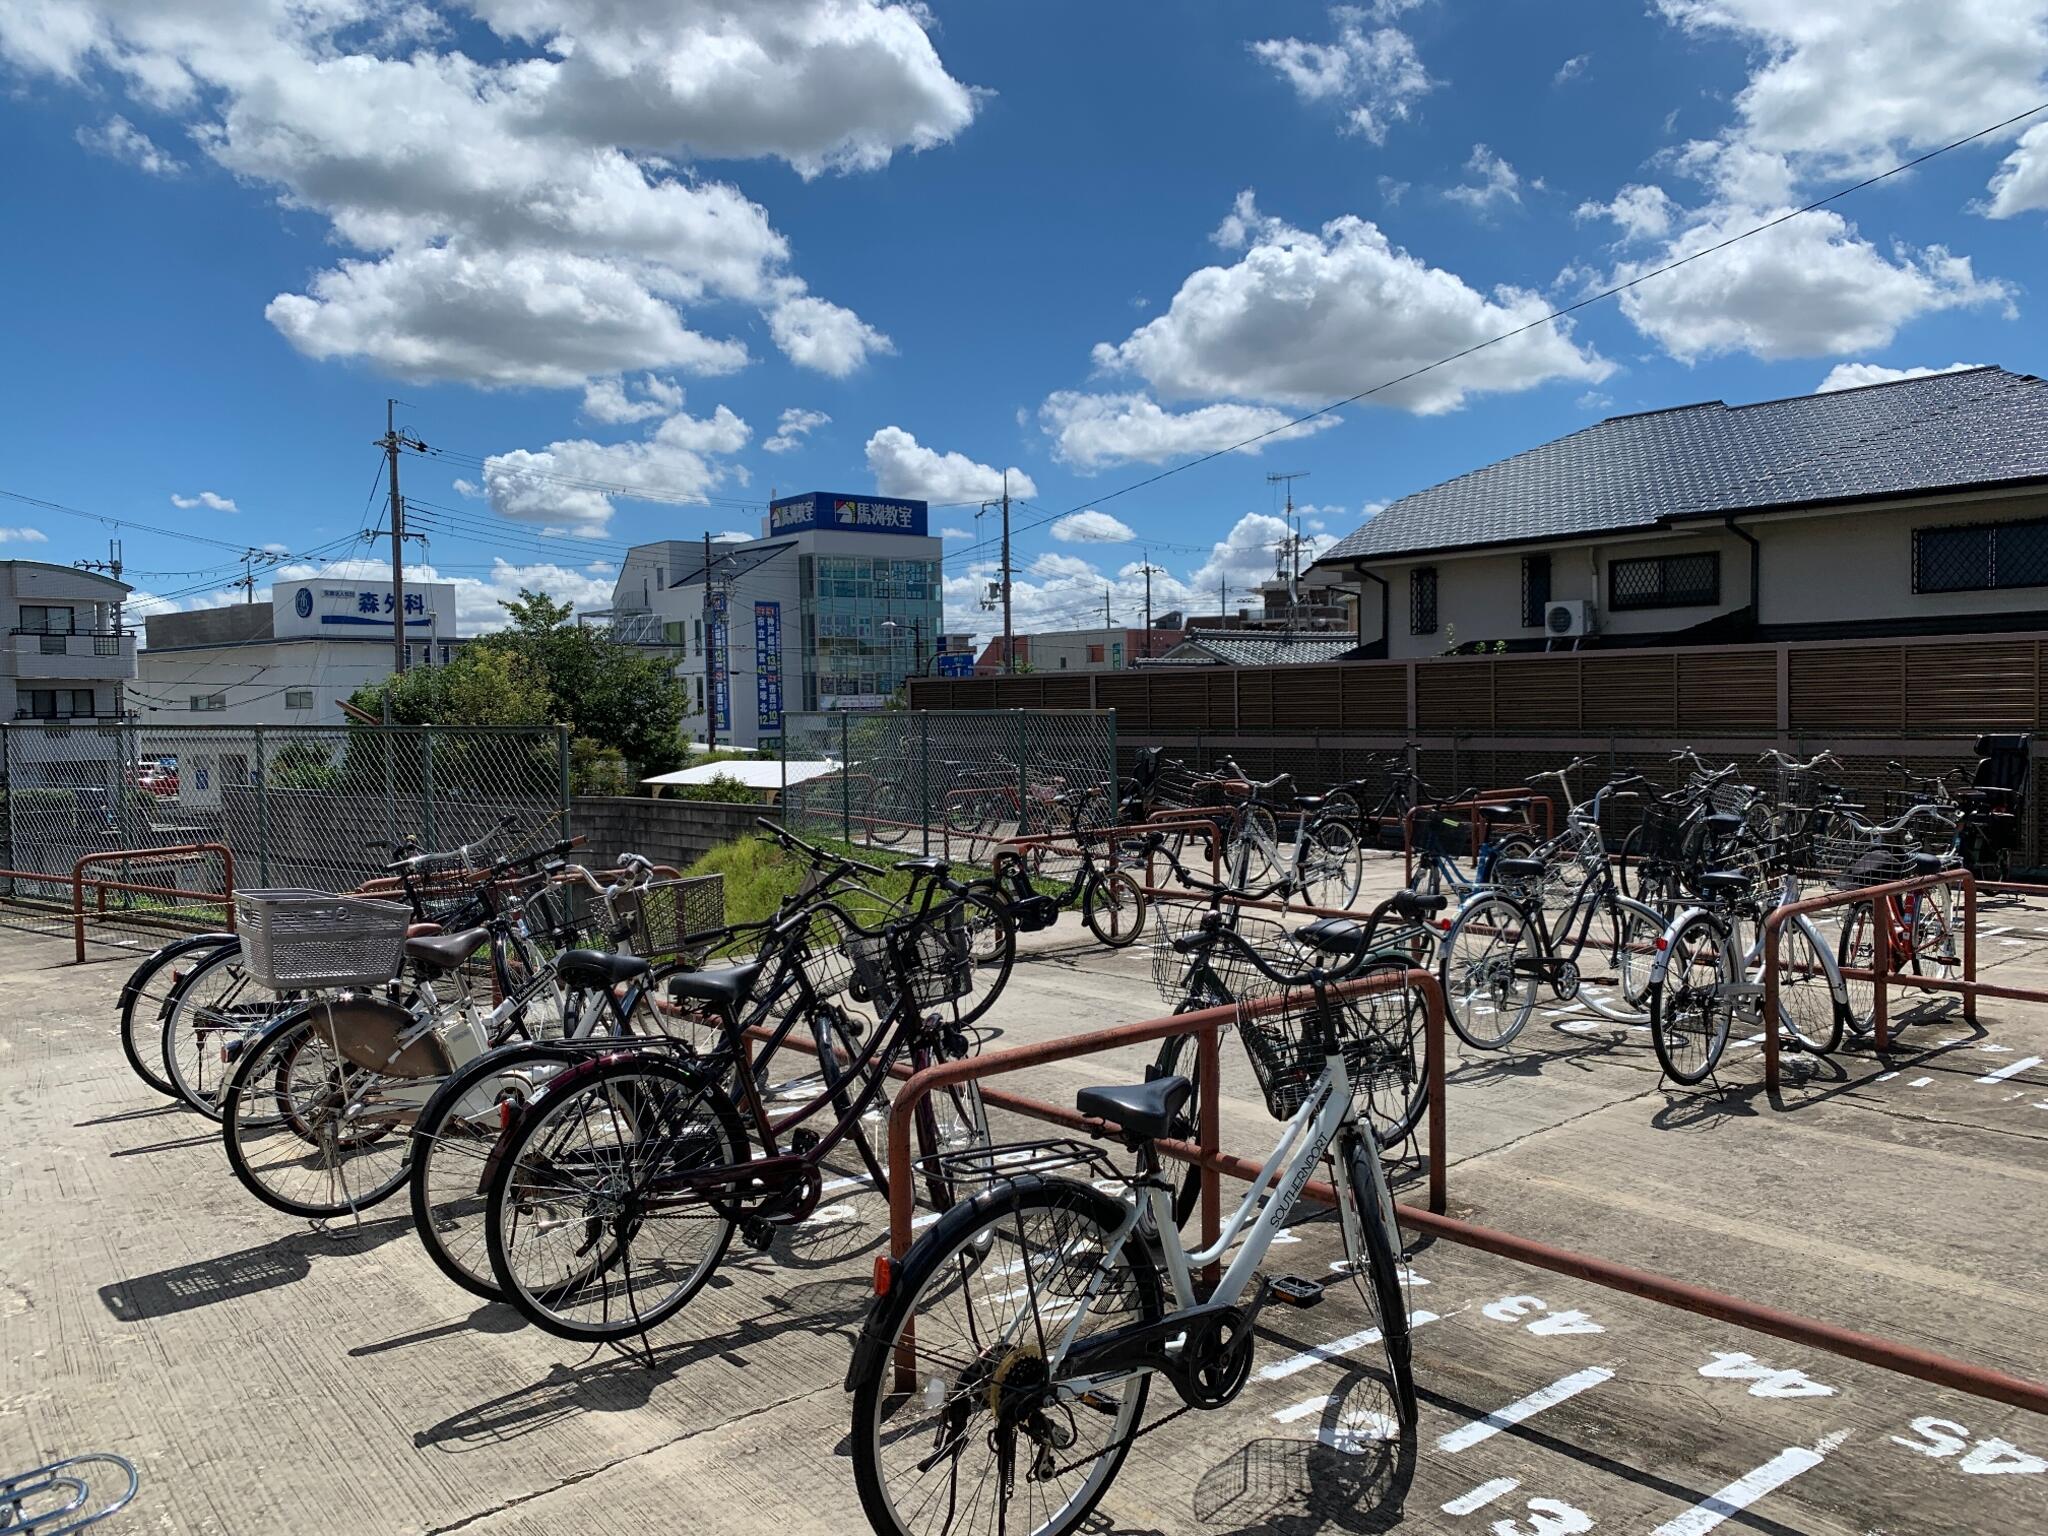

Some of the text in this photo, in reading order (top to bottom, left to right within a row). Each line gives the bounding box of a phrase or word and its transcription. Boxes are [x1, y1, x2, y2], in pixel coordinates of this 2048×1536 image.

[516, 968, 553, 1001] Volkswagen
[1270, 1131, 1329, 1228] SOUTHERNPORT
[1482, 1295, 1606, 1336] 43
[1697, 1351, 1840, 1399] 44
[1889, 1415, 2048, 1476] 45
